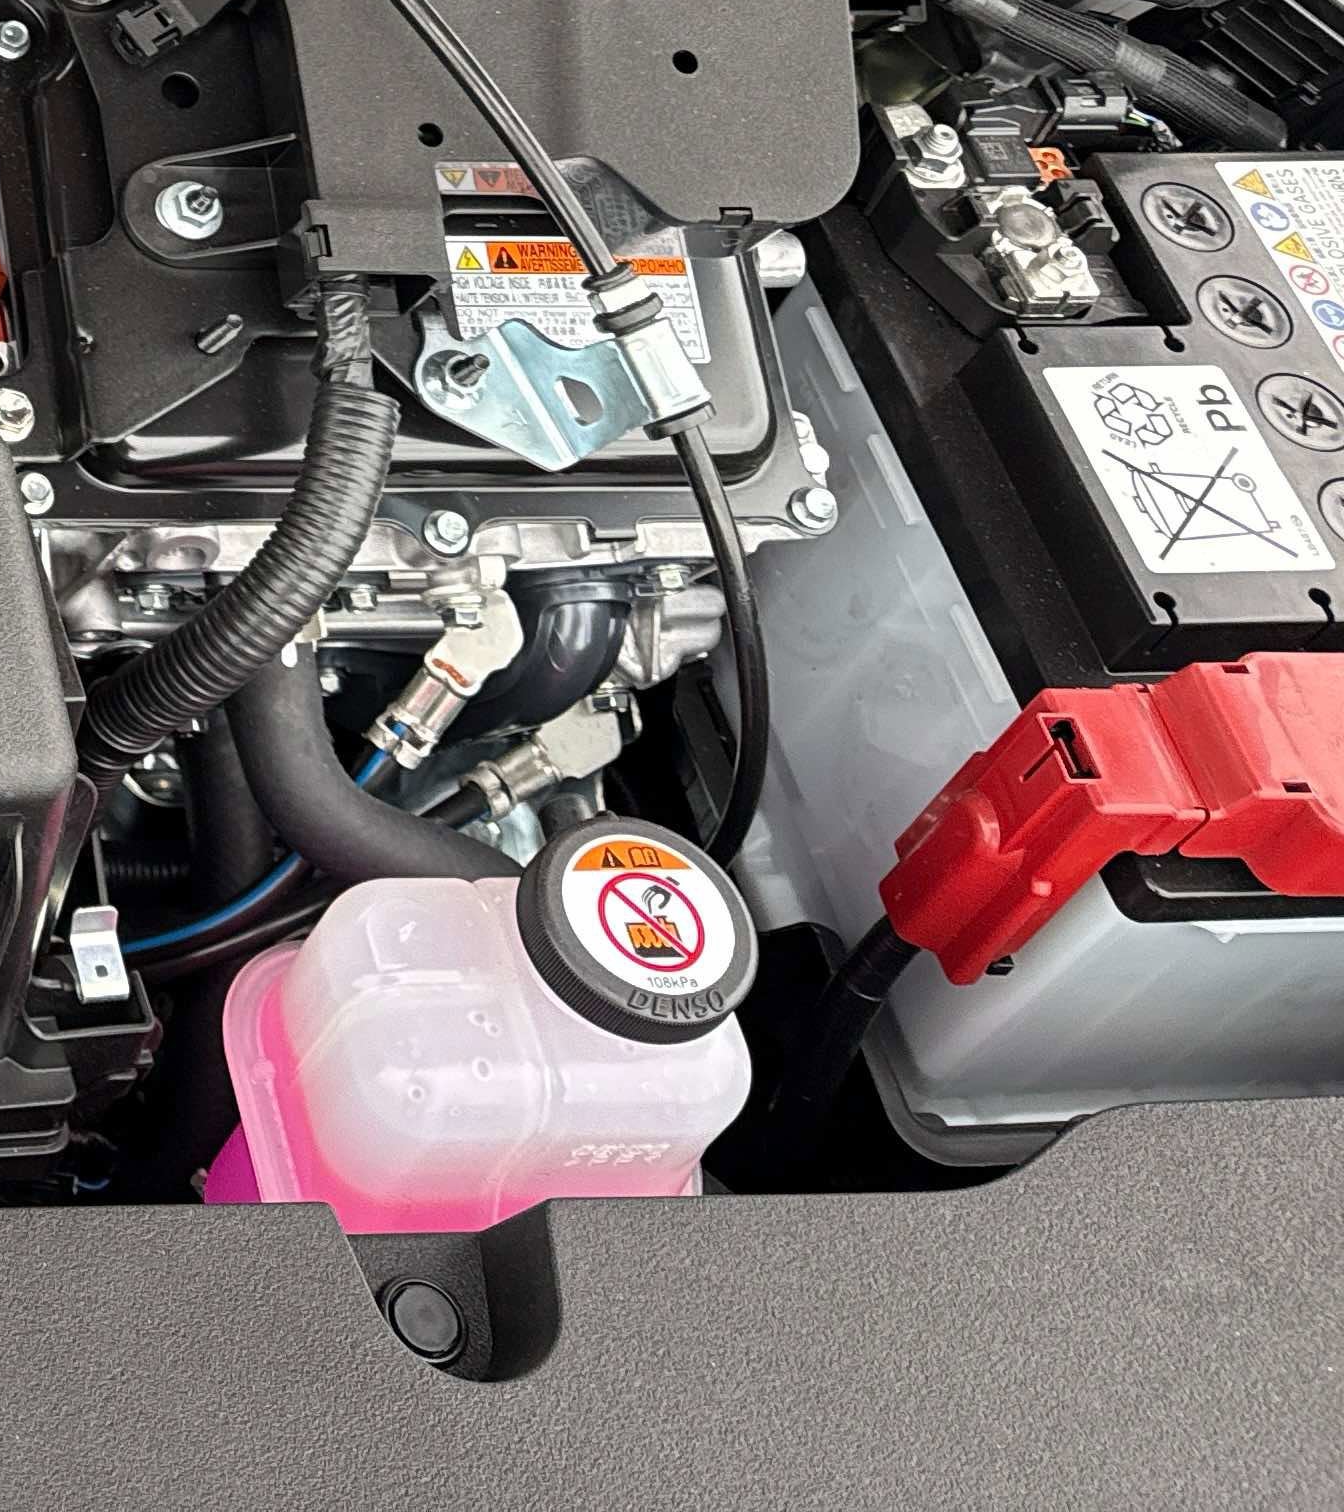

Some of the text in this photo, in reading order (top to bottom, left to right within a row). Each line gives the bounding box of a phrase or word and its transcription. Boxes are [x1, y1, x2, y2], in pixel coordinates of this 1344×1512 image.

[517, 243, 578, 258] WARNING
[1162, 396, 1192, 435] RECYCLE
[1197, 383, 1248, 433] Pb
[1109, 432, 1137, 449] LEAD
[626, 988, 725, 1020] DENSO
